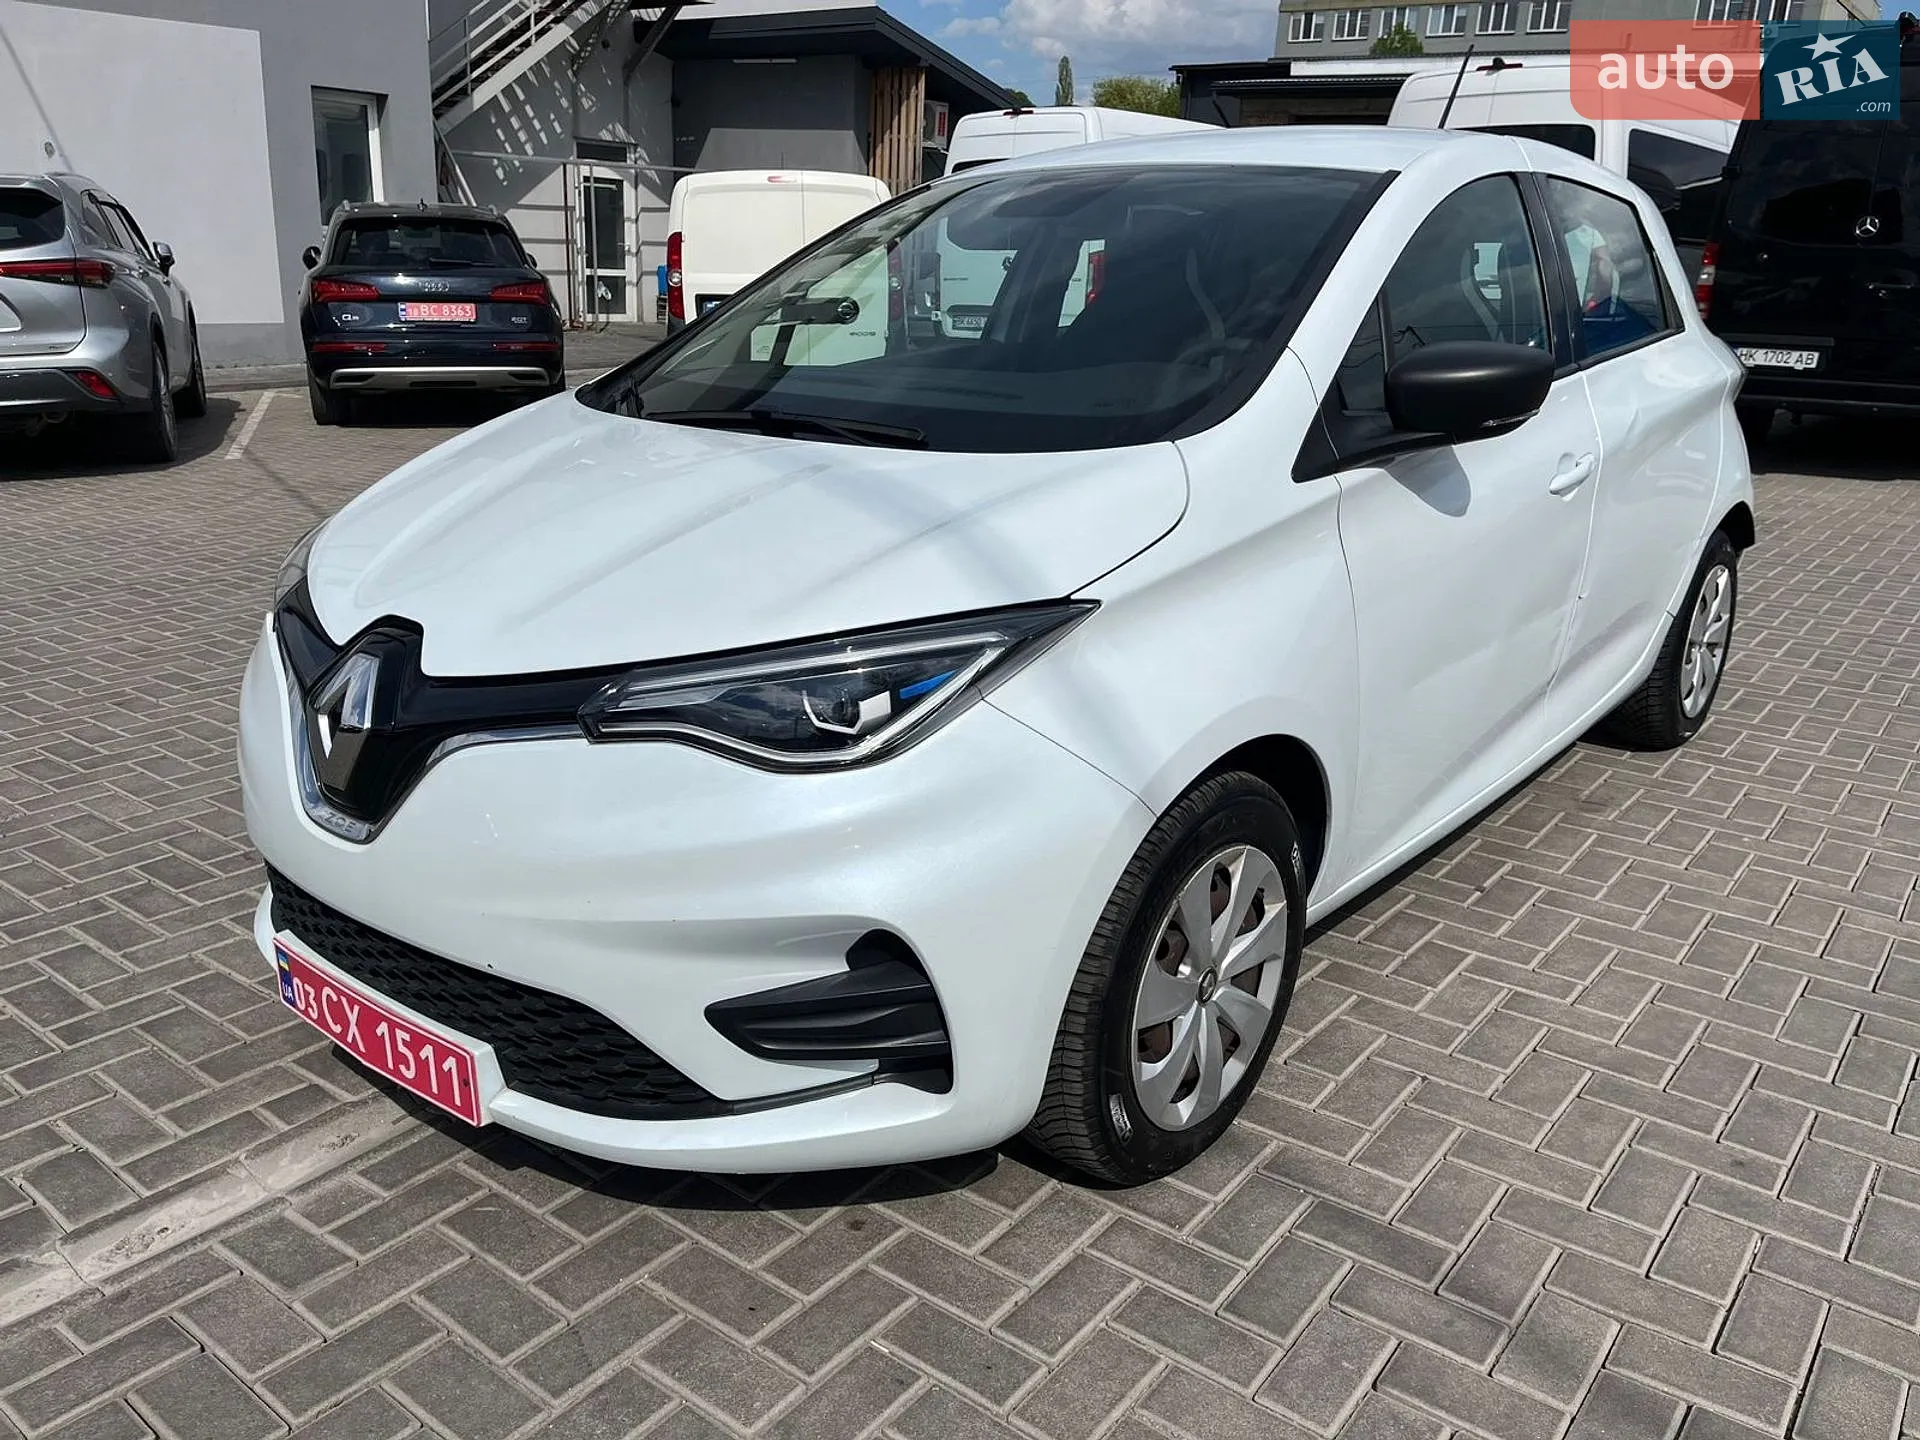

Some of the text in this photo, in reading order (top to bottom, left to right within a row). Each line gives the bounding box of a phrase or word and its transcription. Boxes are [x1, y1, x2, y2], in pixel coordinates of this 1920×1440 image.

[442, 305, 472, 317] 8363
[1762, 350, 1793, 365] 1702
[1794, 351, 1816, 367] AB
[324, 811, 357, 833] ZOE
[282, 982, 294, 1001] UA
[375, 1020, 461, 1107] 1511
